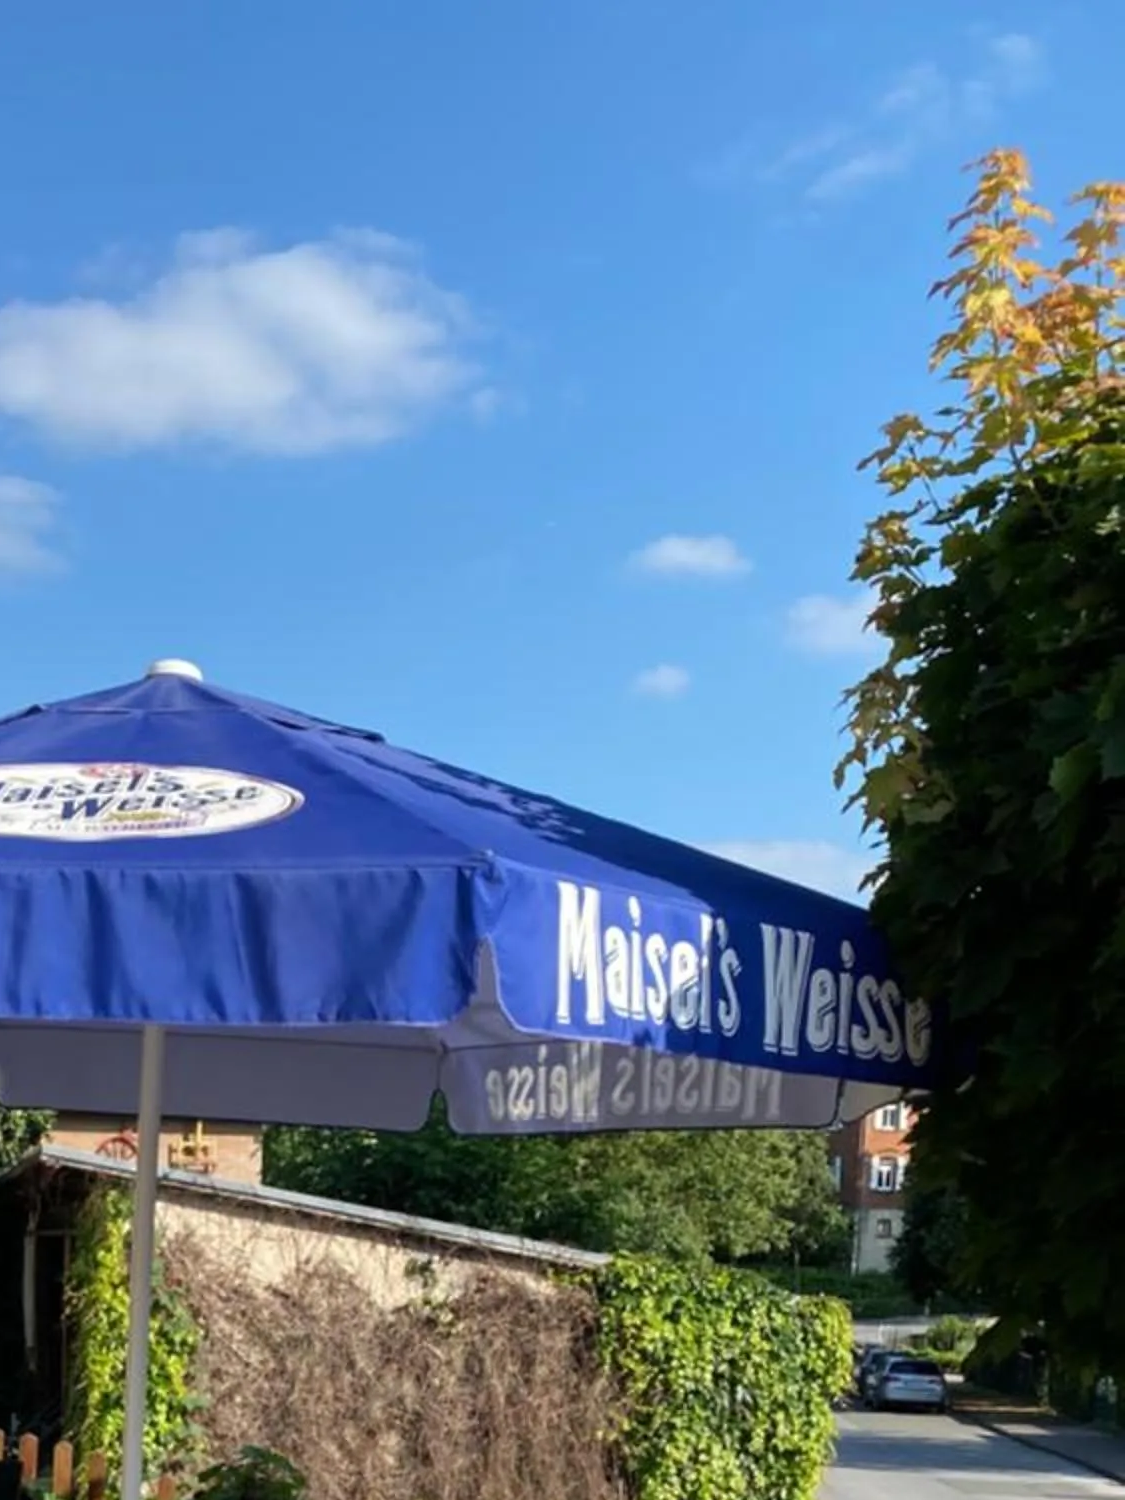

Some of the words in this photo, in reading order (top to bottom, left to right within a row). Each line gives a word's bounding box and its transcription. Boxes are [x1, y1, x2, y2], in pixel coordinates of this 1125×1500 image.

[61, 786, 259, 820] Weisse
[555, 880, 743, 1039] Maisel's
[759, 922, 935, 1068] Weisse
